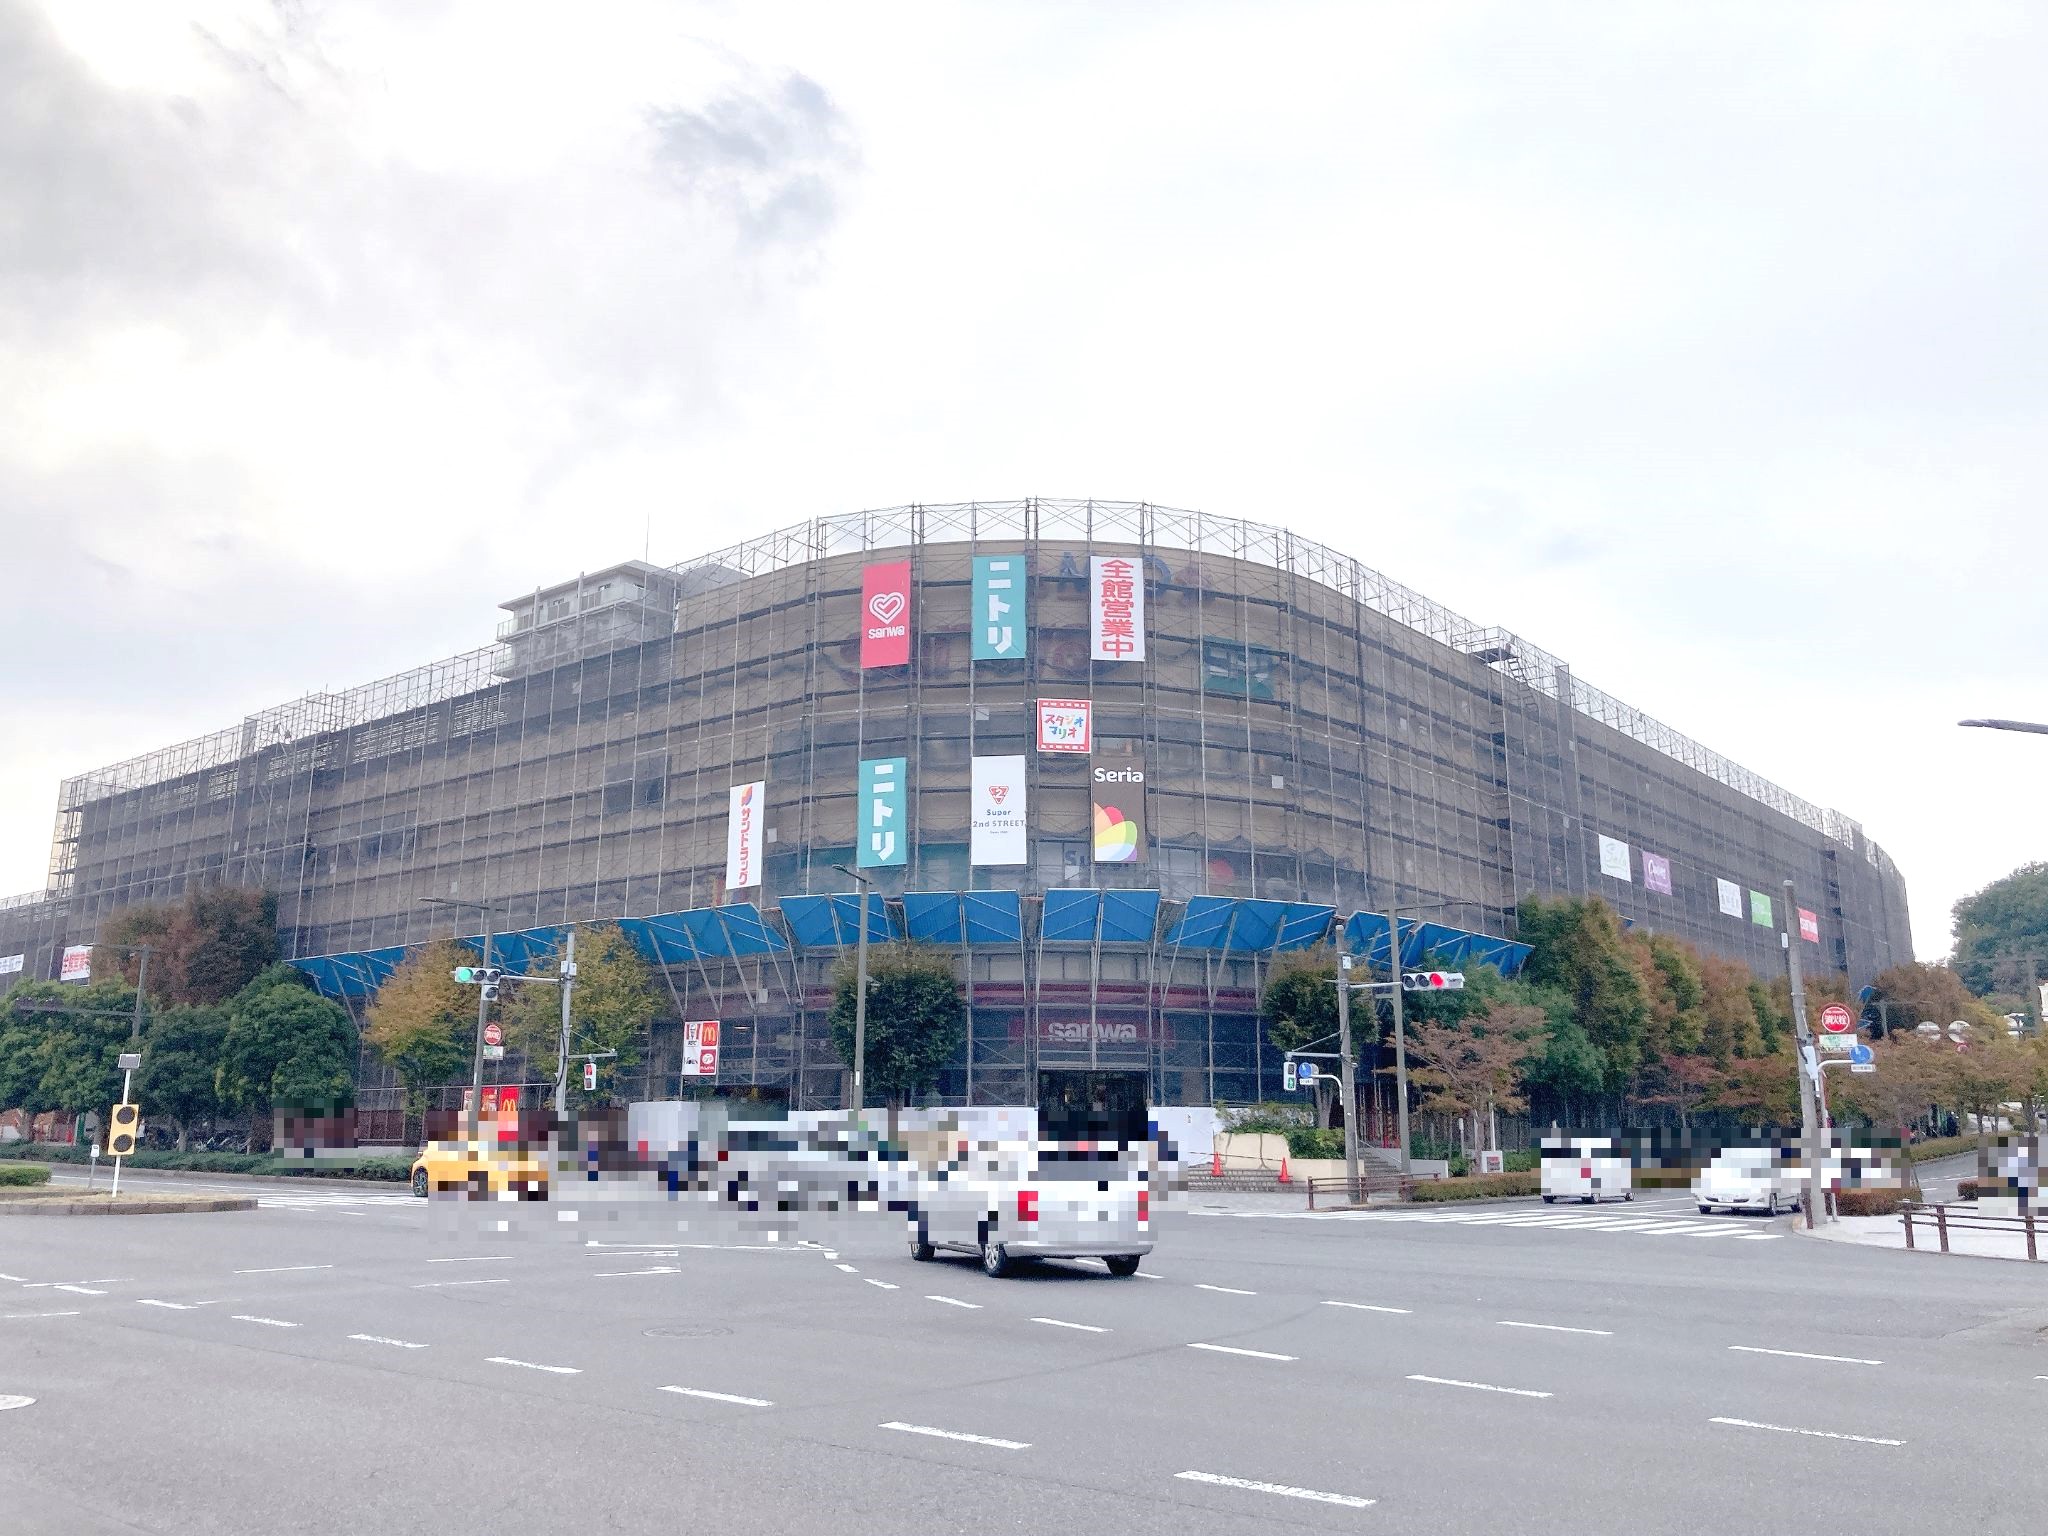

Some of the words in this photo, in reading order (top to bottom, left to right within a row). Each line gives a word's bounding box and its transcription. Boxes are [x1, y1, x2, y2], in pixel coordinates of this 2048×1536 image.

[987, 561, 1012, 654] ニトリ
[1100, 559, 1134, 659] 全館営業中
[868, 624, 905, 640] sanwa
[1044, 714, 1084, 727] スタジオ
[1049, 726, 1077, 739] マリオ
[1094, 766, 1144, 783] Seria
[871, 764, 895, 862] ニトリ
[986, 809, 1012, 817] Super
[972, 820, 990, 828] 2nd
[992, 819, 1025, 827] STREET
[1048, 1022, 1137, 1043] sanwa
